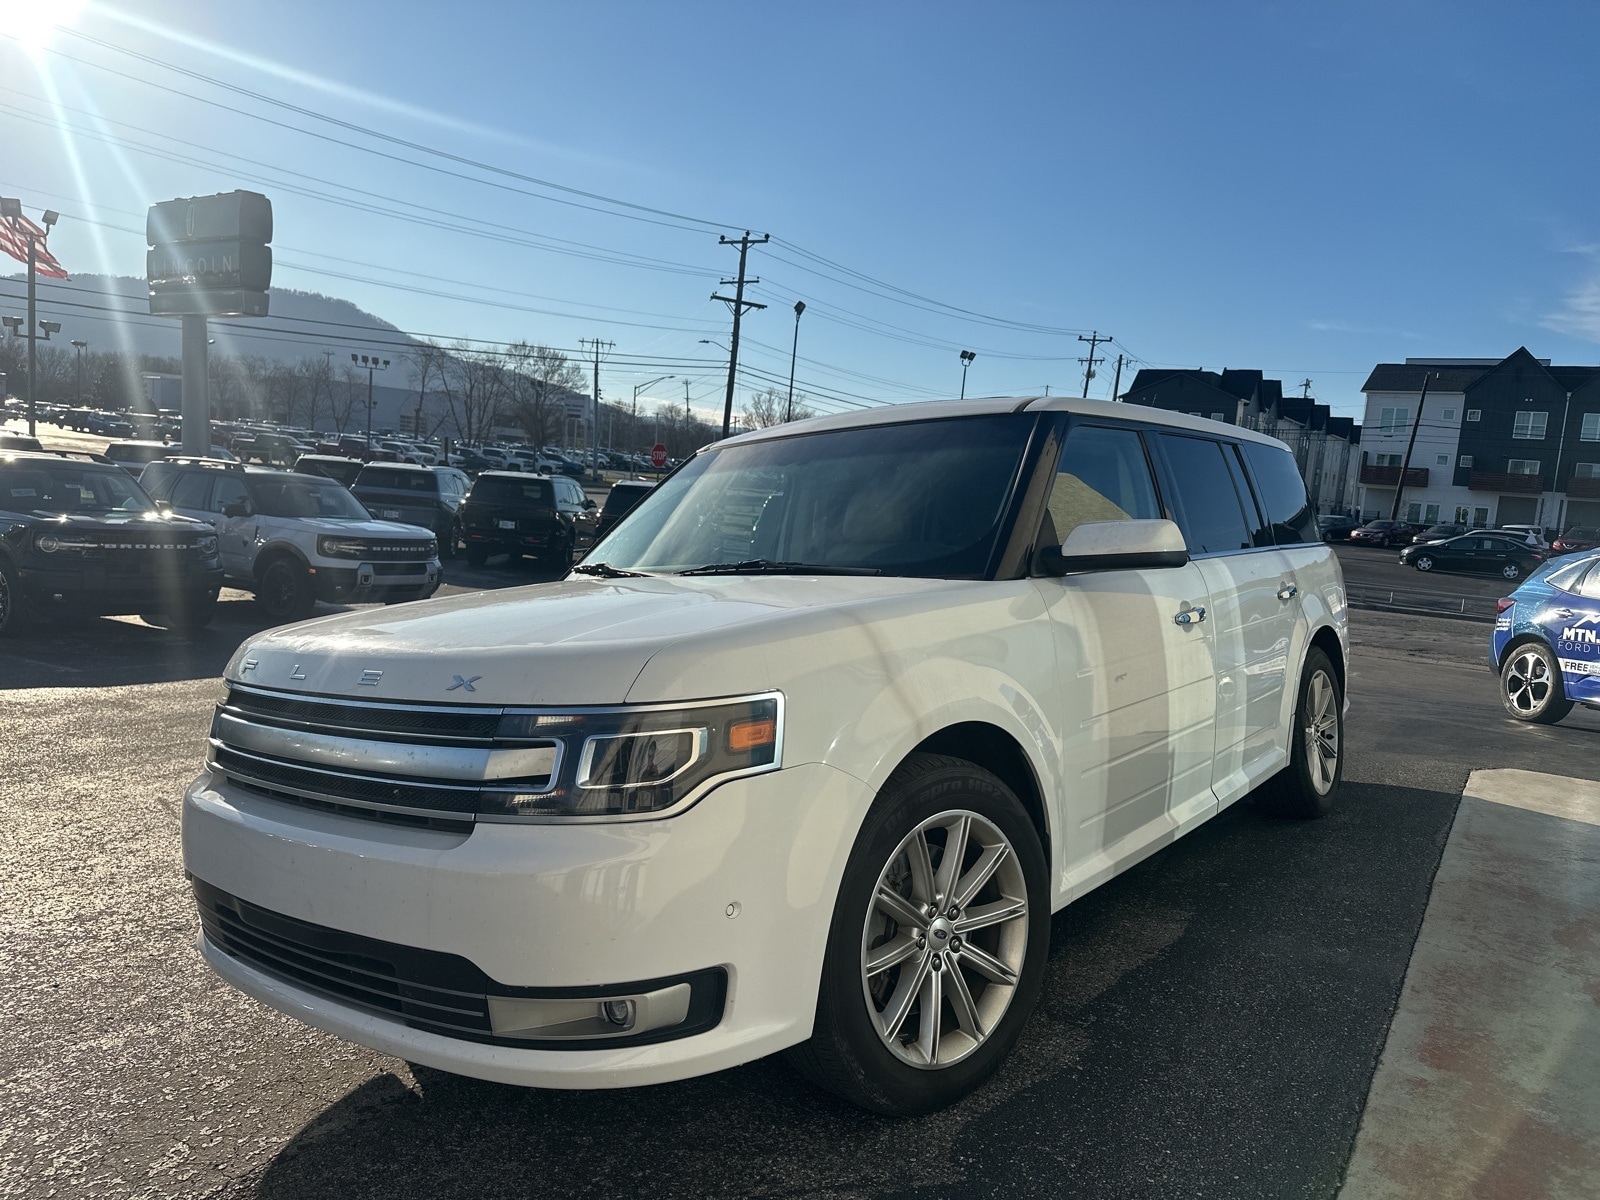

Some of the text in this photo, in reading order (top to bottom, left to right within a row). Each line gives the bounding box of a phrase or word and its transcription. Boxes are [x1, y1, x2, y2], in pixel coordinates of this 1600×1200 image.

[152, 256, 232, 277] LINCOLN
[652, 450, 667, 460] STOP
[1558, 641, 1591, 653] FORD
[1565, 661, 1589, 672] FREE
[241, 659, 482, 692] FLEX
